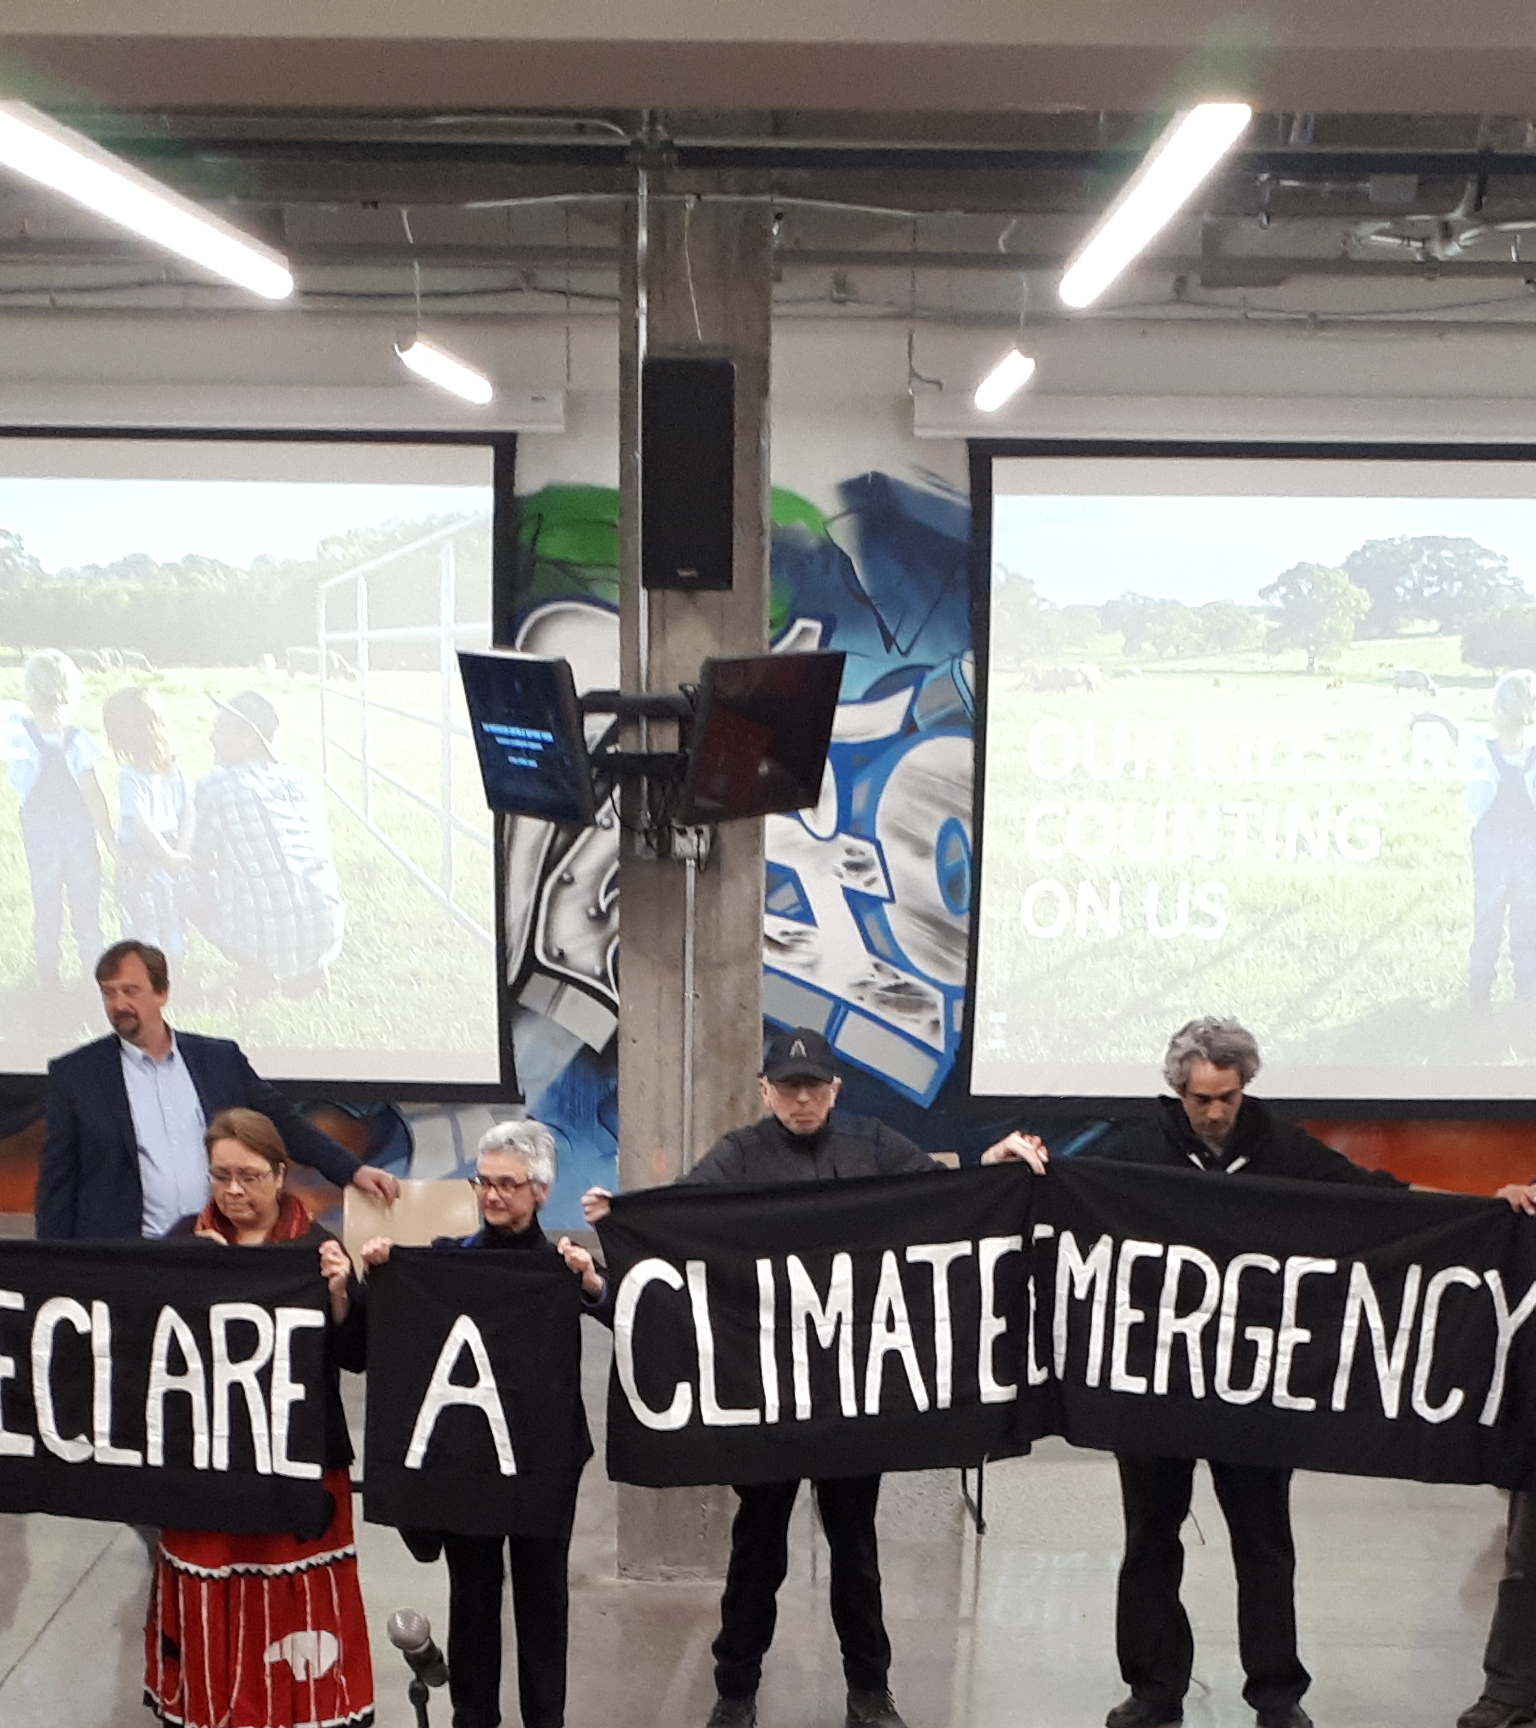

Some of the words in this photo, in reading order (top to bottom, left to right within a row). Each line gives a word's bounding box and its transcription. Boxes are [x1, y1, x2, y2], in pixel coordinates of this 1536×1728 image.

[1027, 718, 1172, 781] OUR
[1196, 720, 1342, 782] KIDS
[1357, 721, 1489, 781] ARE
[1024, 800, 1384, 862] COUNTING
[1020, 879, 1121, 939] ON
[1147, 881, 1230, 941] US
[613, 1234, 1023, 1432] CLIMATE
[404, 1314, 517, 1476] A
